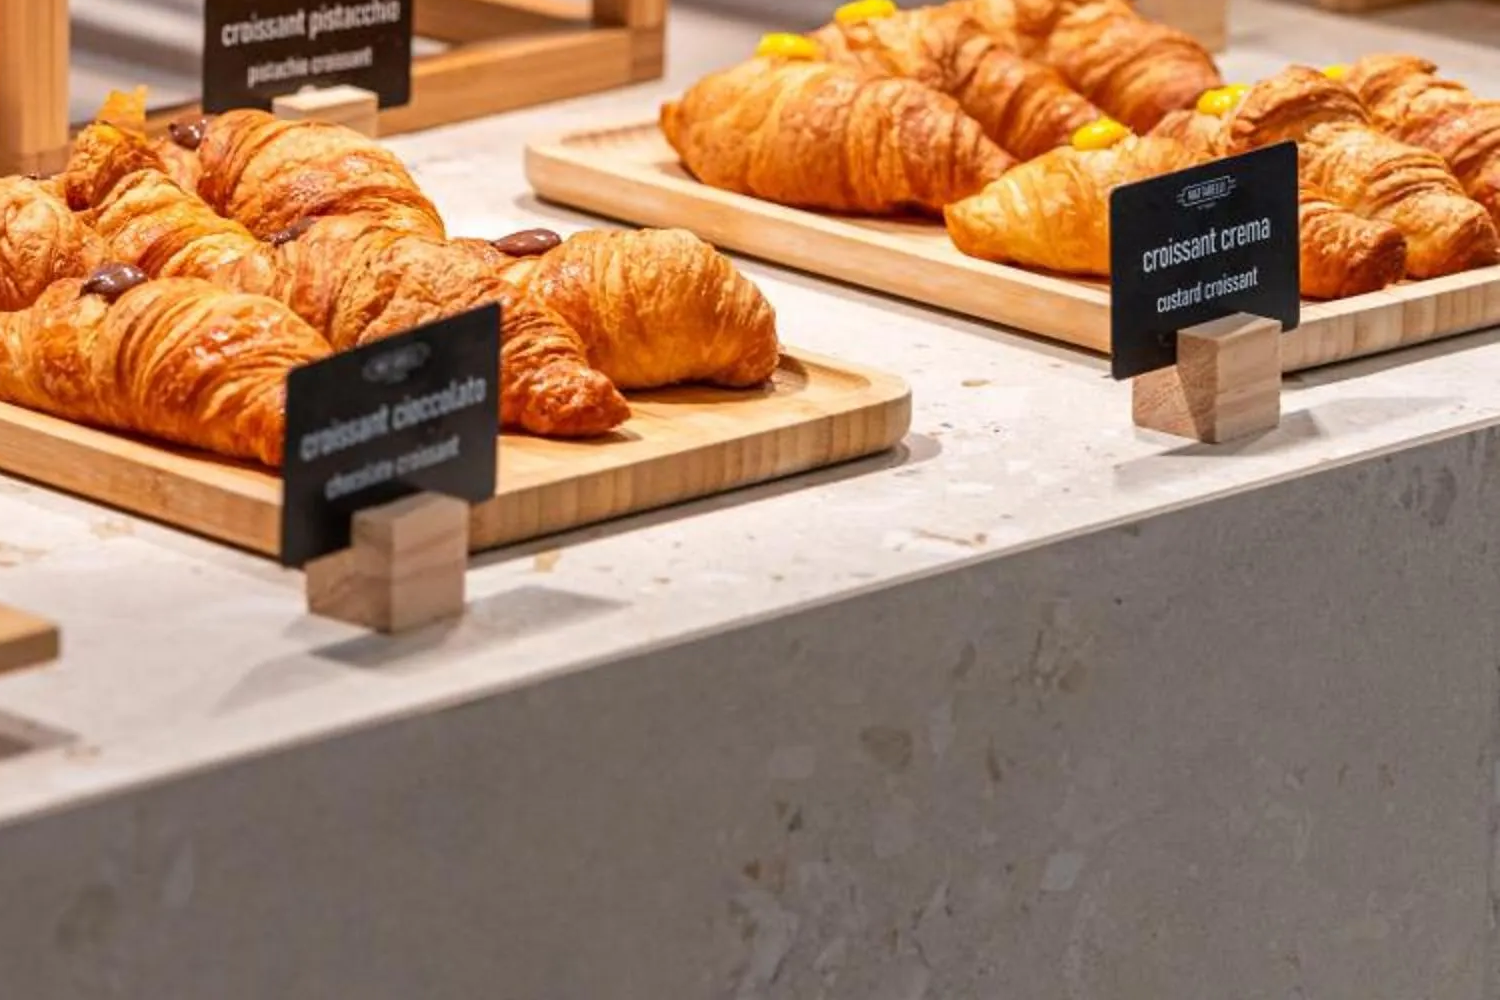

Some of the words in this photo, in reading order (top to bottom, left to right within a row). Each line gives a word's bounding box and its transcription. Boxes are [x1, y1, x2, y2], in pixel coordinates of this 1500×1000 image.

[221, 8, 305, 46] croissant
[311, 46, 373, 74] croissant
[1142, 228, 1217, 273] croissant
[1220, 216, 1271, 250] crema
[1156, 282, 1202, 313] custard
[1203, 267, 1258, 301] croissant
[300, 403, 389, 462] croissant
[391, 375, 487, 431] cioccolato
